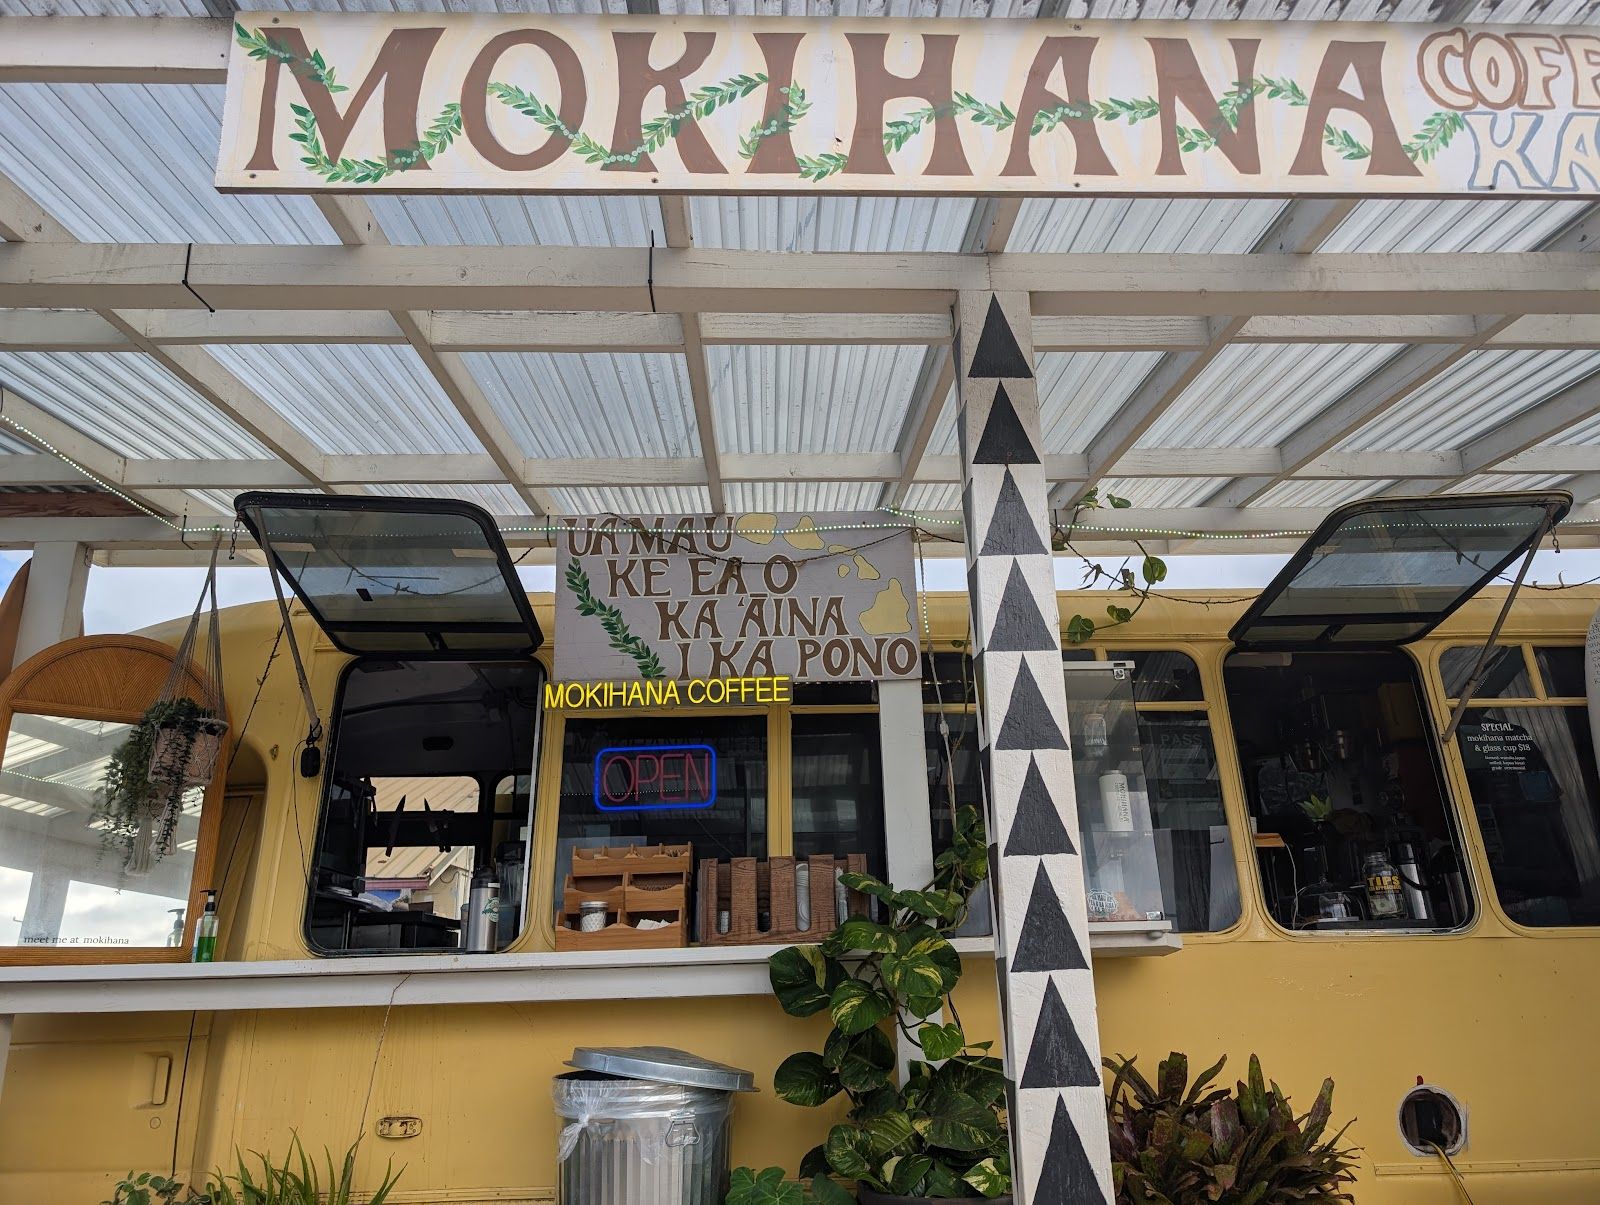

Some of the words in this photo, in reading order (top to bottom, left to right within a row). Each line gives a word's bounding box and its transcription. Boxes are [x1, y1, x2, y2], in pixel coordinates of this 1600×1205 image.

[244, 26, 1423, 177] MOKIHANA
[1462, 111, 1600, 191] KA
[563, 516, 619, 556] UA
[627, 514, 734, 555] MAU
[605, 557, 671, 597] KE
[688, 557, 748, 597] EA
[763, 554, 798, 594] O
[654, 598, 724, 641] KA
[677, 641, 692, 680] I
[708, 639, 775, 680] KA
[796, 637, 918, 679] PONO
[545, 680, 681, 710] MOKIHANA
[687, 676, 790, 705] COFFEE
[1467, 734, 1504, 742] mokihana
[1505, 734, 1533, 742] matcha
[1474, 744, 1481, 752] &
[1482, 744, 1502, 753] glass
[1503, 745, 1517, 753] cup
[1481, 723, 1513, 732] SPECIAL
[603, 753, 710, 802] OPEN
[1367, 875, 1400, 886] TIPS
[24, 936, 49, 944] meet
[69, 936, 79, 944] at
[83, 936, 129, 945] mokihana
